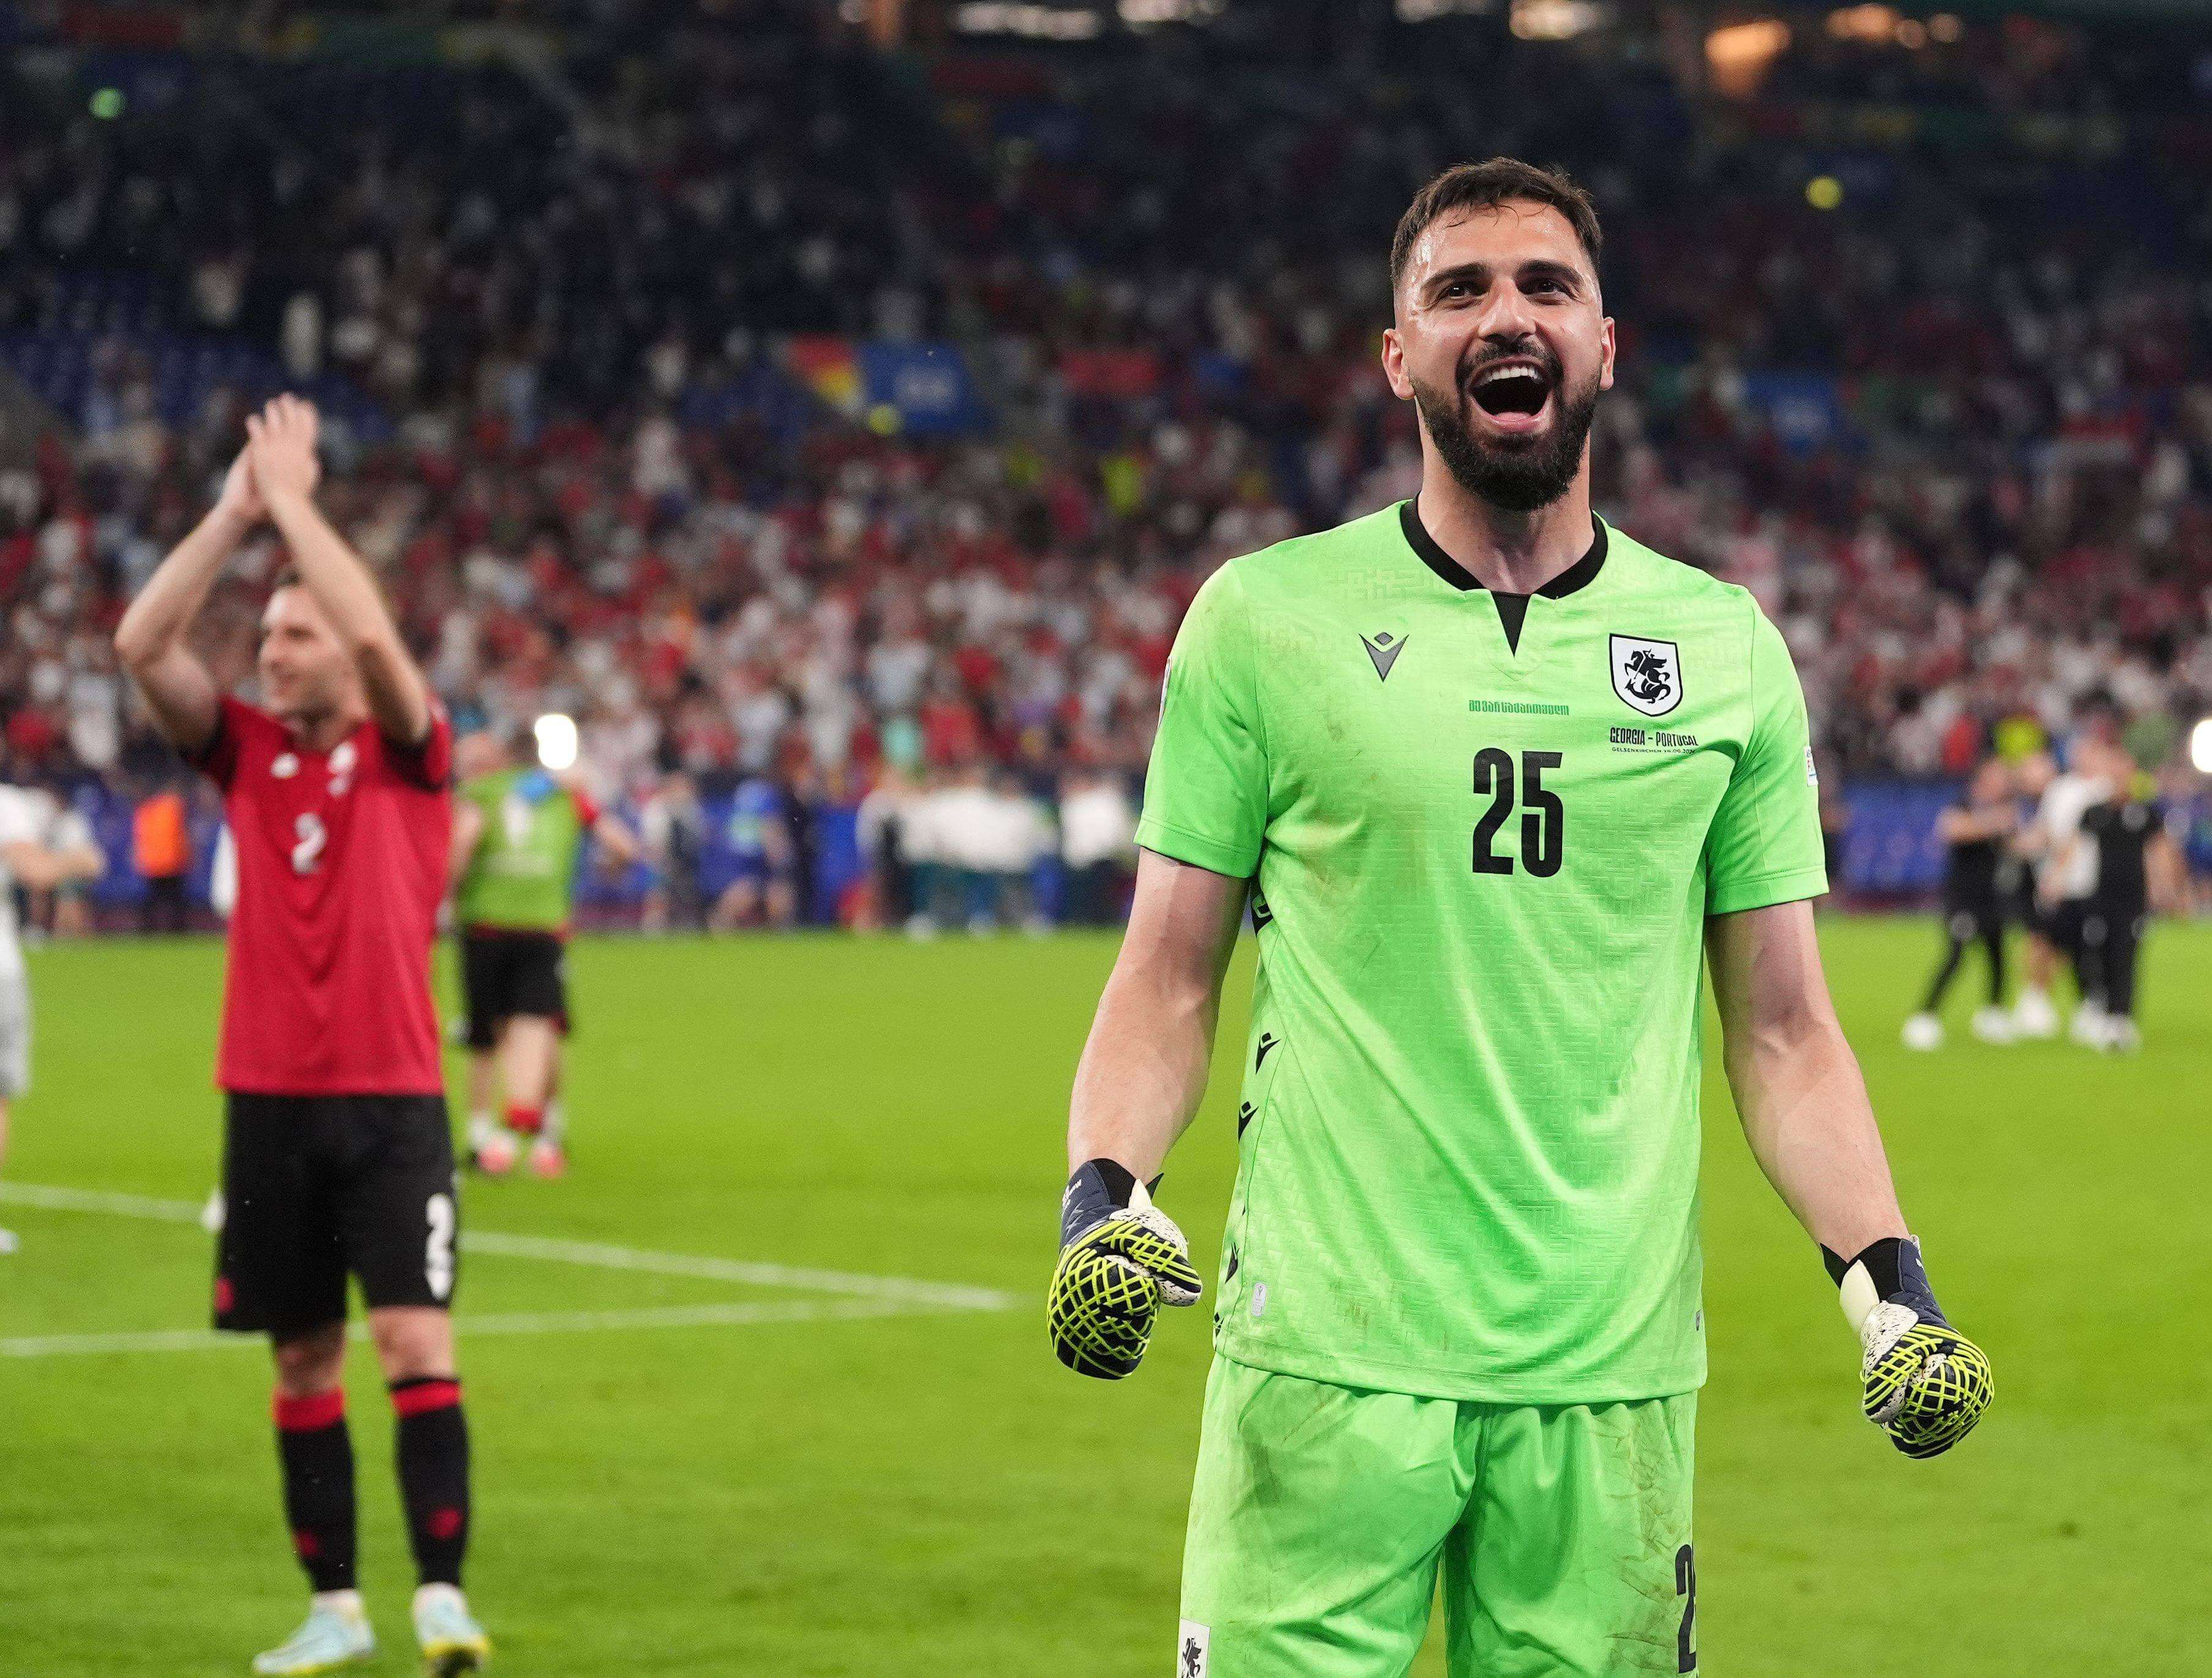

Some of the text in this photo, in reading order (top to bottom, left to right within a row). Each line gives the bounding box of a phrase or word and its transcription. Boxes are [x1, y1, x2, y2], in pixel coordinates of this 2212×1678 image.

[1610, 727, 1645, 745] GEORGIA
[1656, 731, 1699, 747] PORTUGAL
[1472, 747, 1563, 878] 25
